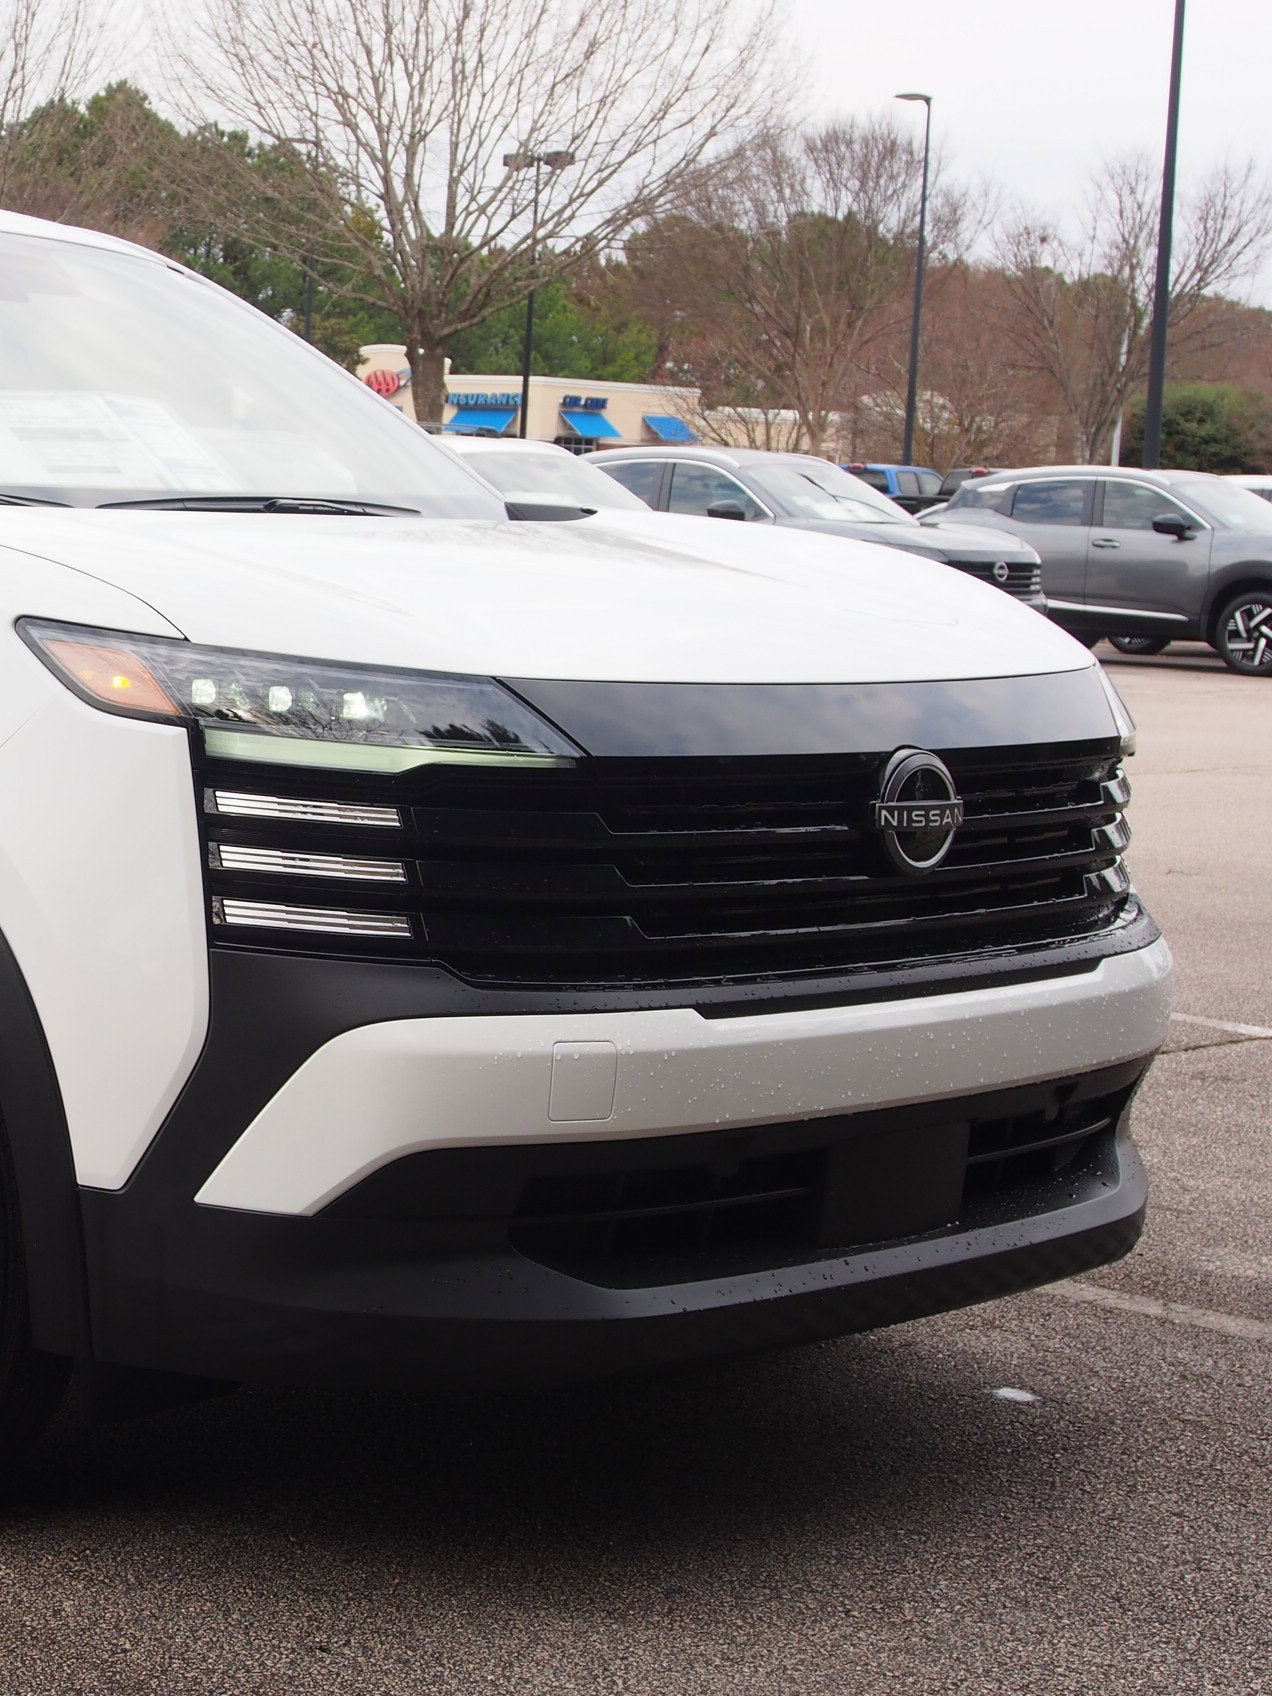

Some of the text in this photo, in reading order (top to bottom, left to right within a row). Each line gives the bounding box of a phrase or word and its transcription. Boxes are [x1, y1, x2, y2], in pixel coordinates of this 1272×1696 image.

[365, 369, 399, 397] AAA
[447, 391, 523, 405] NSURANC
[880, 808, 963, 827] NISSAN
